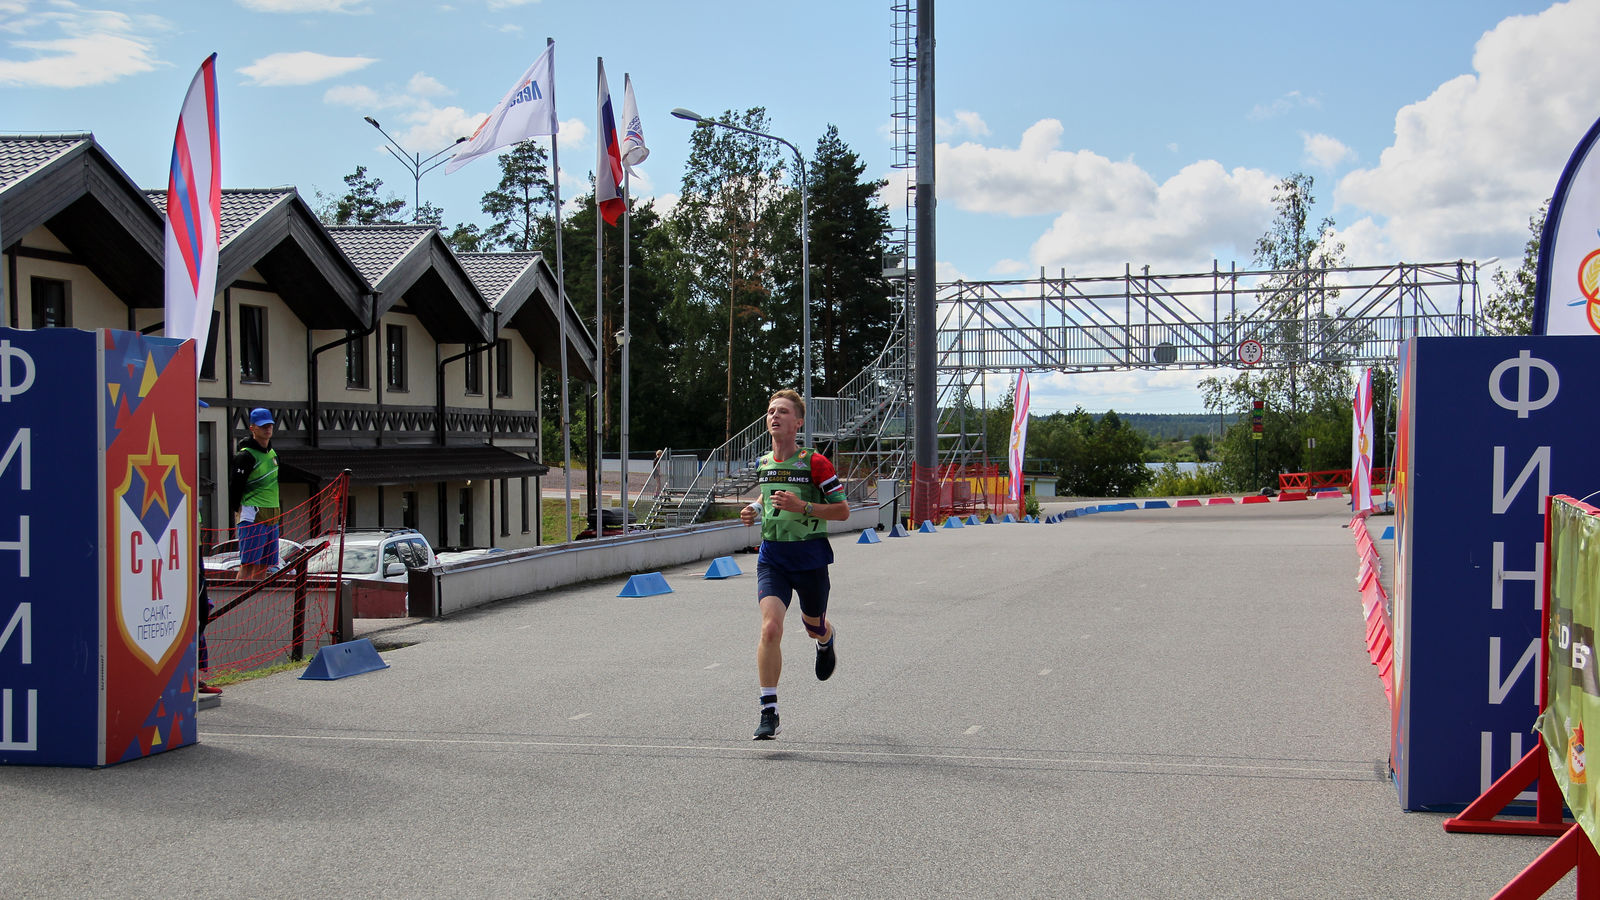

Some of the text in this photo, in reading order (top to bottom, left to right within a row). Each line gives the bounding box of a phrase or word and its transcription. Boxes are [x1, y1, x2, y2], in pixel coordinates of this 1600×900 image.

[130, 528, 180, 601] СКА
[143, 604, 173, 623] САНКТ-
[137, 620, 177, 641] ПЕТЕРБУРГ
